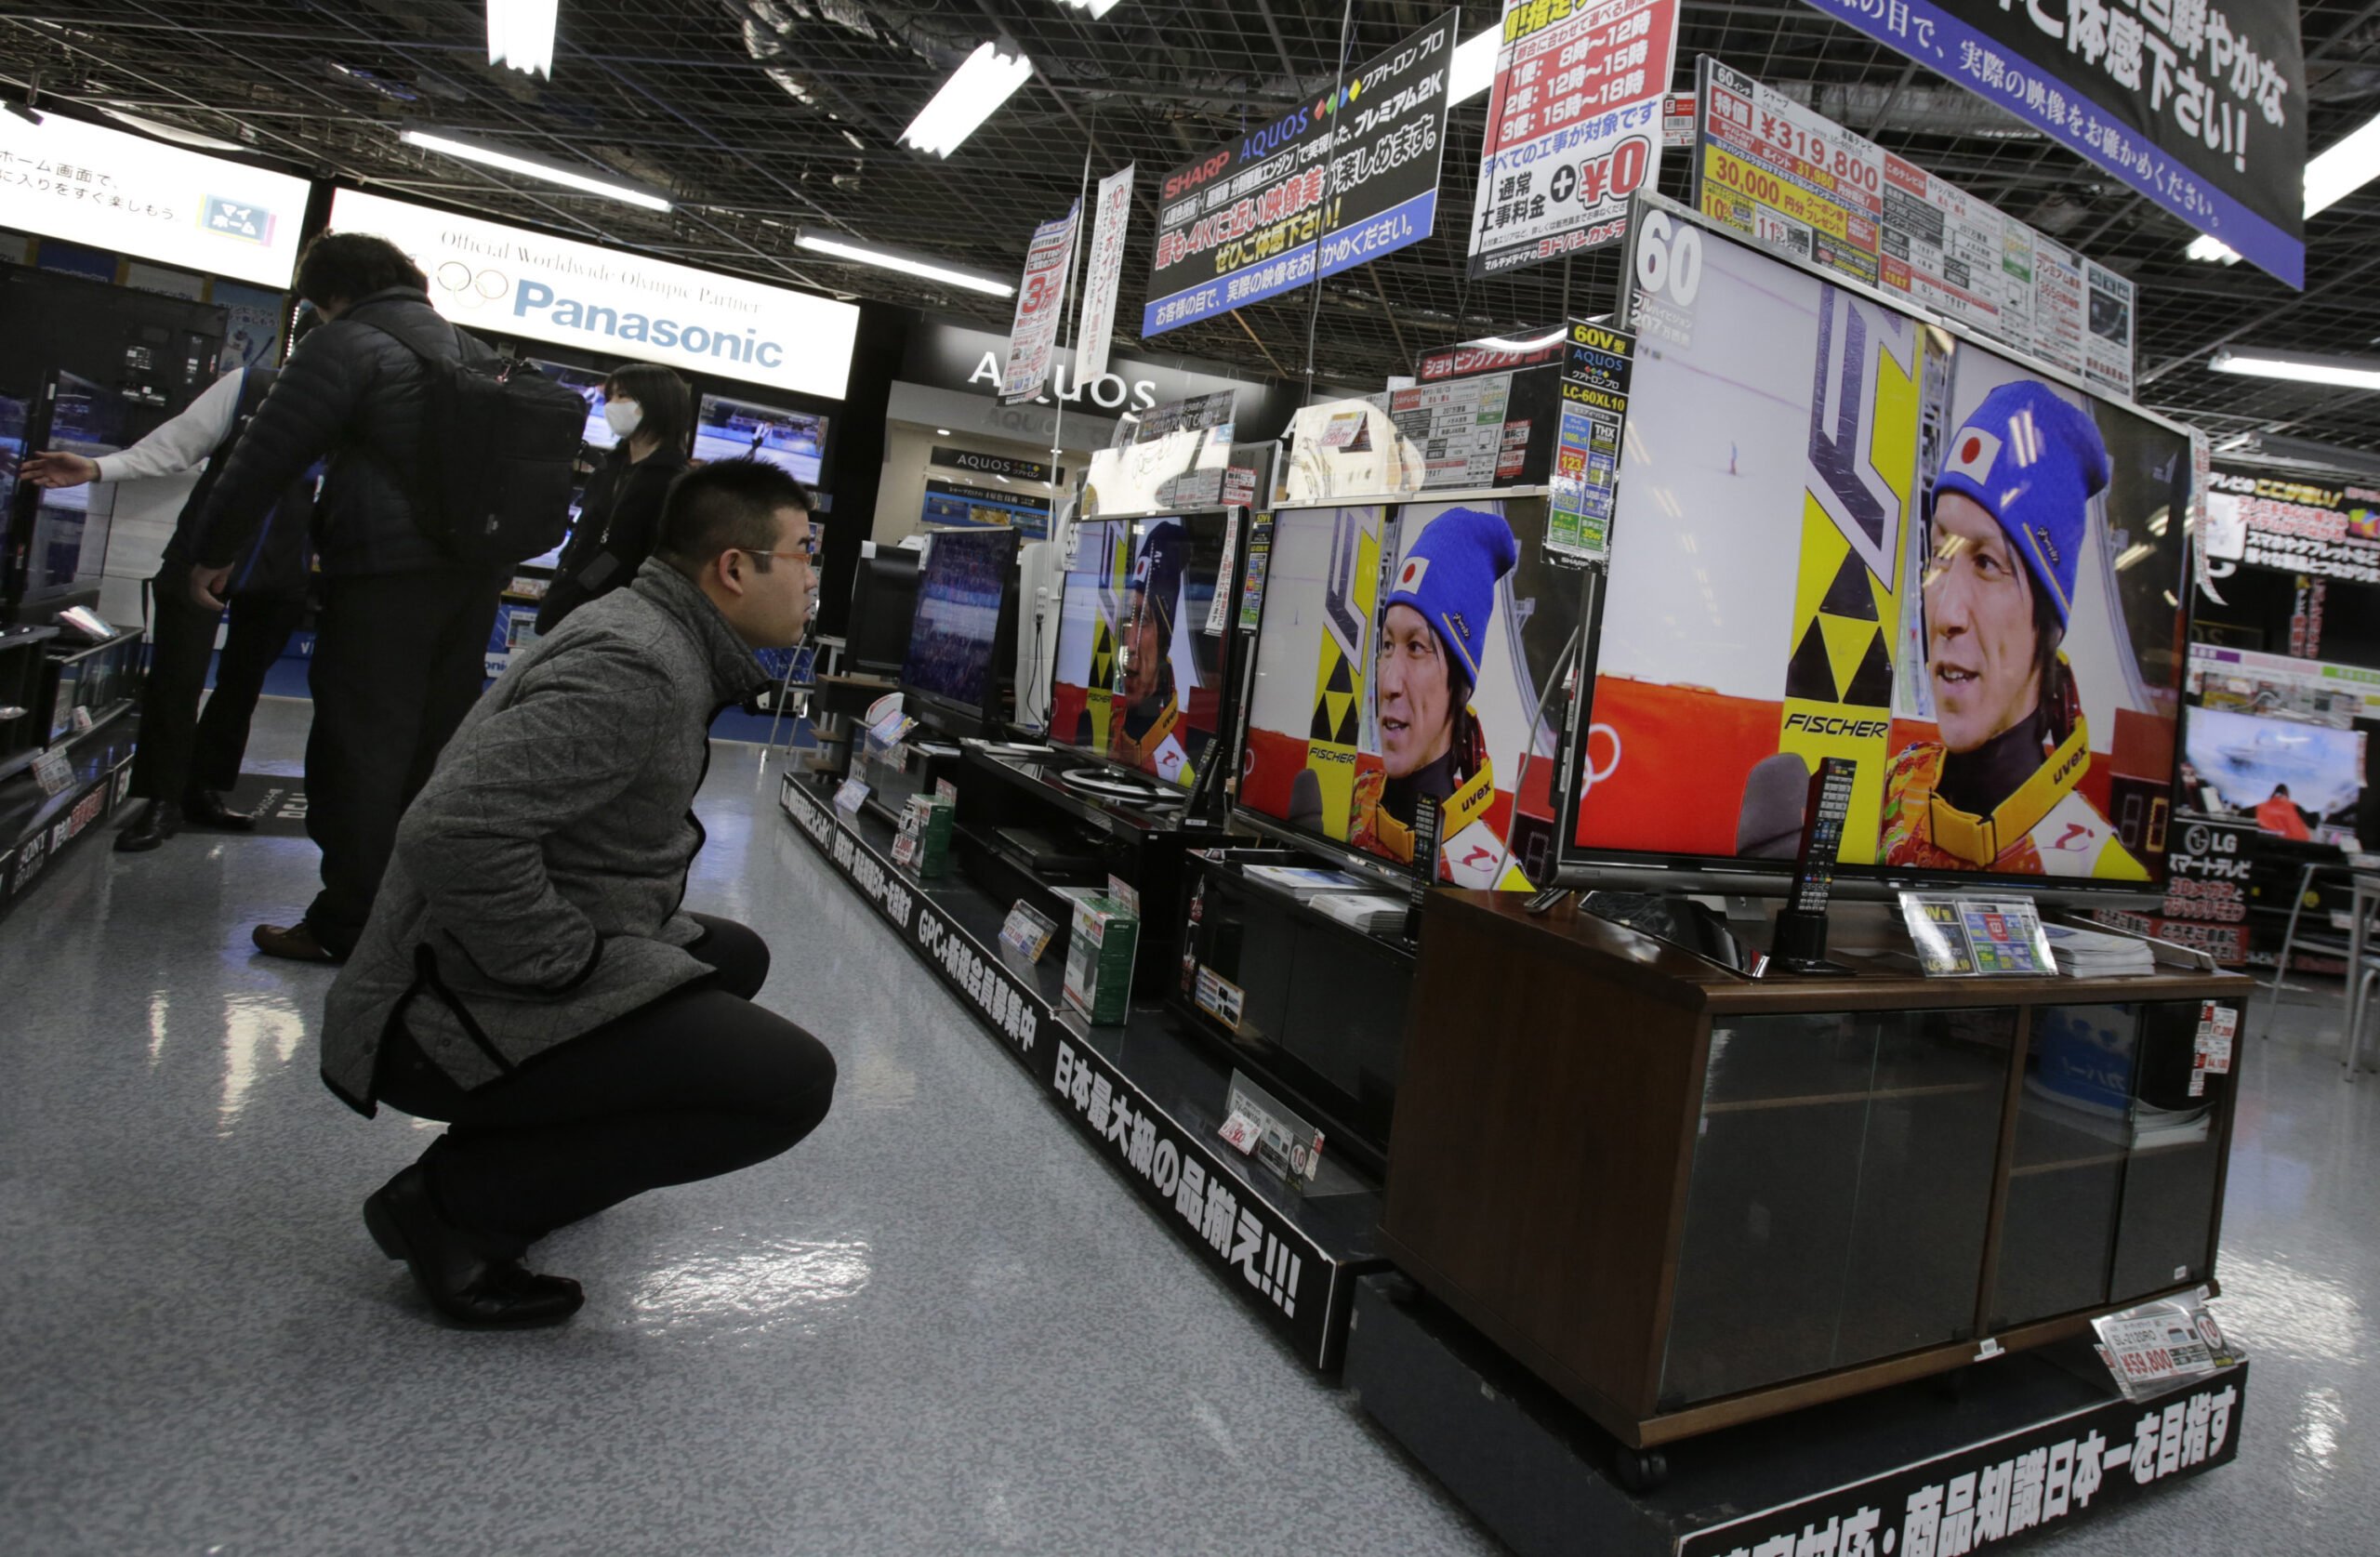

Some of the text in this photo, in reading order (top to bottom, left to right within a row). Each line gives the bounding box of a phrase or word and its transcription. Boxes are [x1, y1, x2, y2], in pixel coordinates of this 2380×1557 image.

[1361, 28, 1445, 94] クアトロン プロ
[2000, 0, 2247, 173] 体感下さい！
[1164, 107, 1309, 199] SHARP AQUOS
[1484, 100, 1657, 178] すべての工事が対象です
[1714, 89, 1750, 127] 特価
[1761, 111, 1878, 192] ¥319,800
[1498, 171, 1532, 203] 通常
[1716, 155, 1780, 205] 30,000
[213, 215, 257, 235] ホーム
[221, 204, 252, 220] マイ
[1479, 193, 1546, 233] 工事料金
[441, 231, 764, 314] Official Worldwide Olympic Partner
[1636, 209, 1702, 307] 60
[513, 279, 784, 368] Panasonic
[1574, 324, 1626, 354] 60V型
[968, 350, 1156, 412] AUOS
[1573, 348, 1624, 372] AQUOS
[1563, 384, 1625, 412] LC-60XL10
[1594, 423, 1616, 440] THX
[958, 454, 1011, 472] AQUOS
[1784, 712, 1889, 739] FISCHER
[1308, 747, 1355, 765] FISCHER
[2052, 743, 2089, 786] uvex
[1461, 782, 1492, 813] uvex
[2212, 833, 2238, 853] LG
[919, 908, 1038, 1052] GPC+新規会員募集中
[1293, 1146, 1305, 1168] 10
[1053, 1039, 1302, 1319] 日本最大級の品揃え!!!
[2120, 1320, 2218, 1376] ¥59,800 10
[1709, 1385, 2237, 1557] 対応・商品知識日本一を目指す
